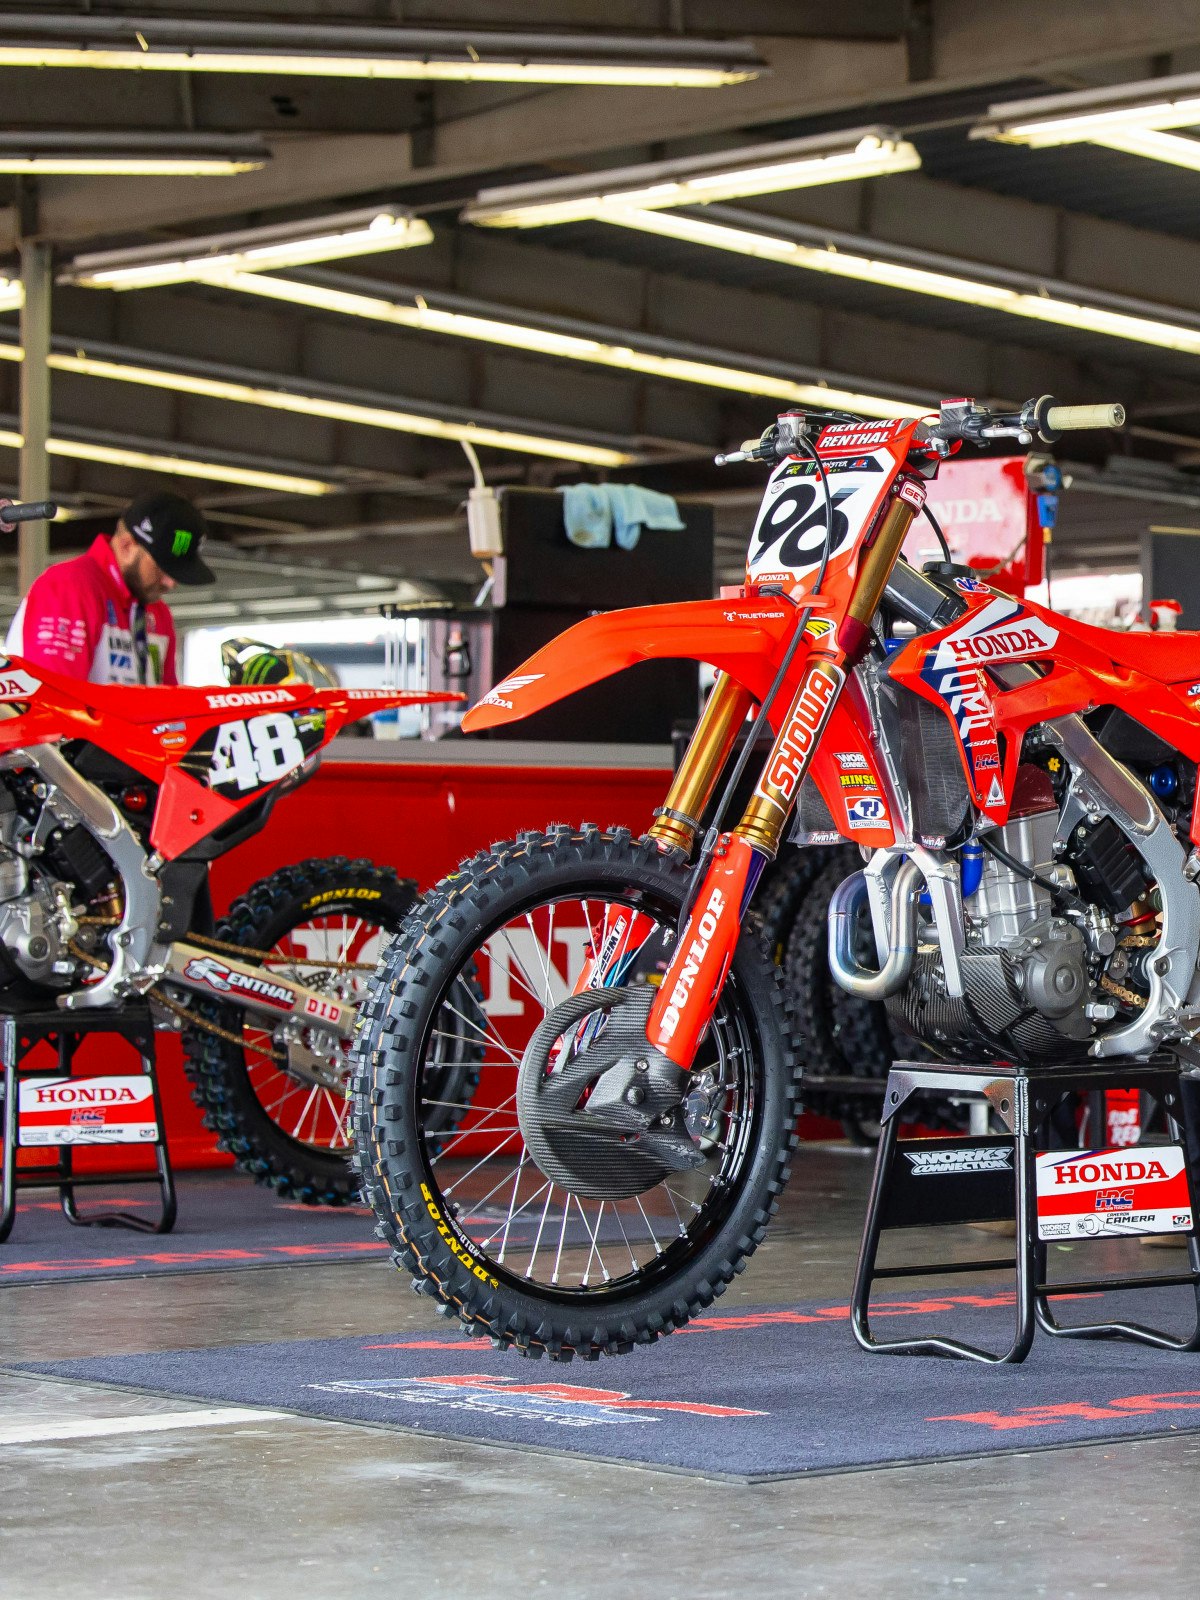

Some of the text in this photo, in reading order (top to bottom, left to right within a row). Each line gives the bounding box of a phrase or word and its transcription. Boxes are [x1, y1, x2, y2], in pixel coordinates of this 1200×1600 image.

[820, 433, 890, 448] RENTHAL
[758, 483, 849, 568] 96
[757, 574, 790, 582] HONDA
[947, 628, 1048, 662] HONDA
[206, 689, 296, 709] HONDA
[938, 670, 994, 740] CRF
[768, 670, 836, 800] SHOWA
[209, 712, 304, 790] 48
[976, 754, 999, 768] HRC
[840, 774, 877, 786] HINSO
[860, 801, 879, 817] TJ
[812, 833, 828, 842] Twin
[308, 888, 382, 907] DUNLOP
[660, 887, 725, 1038] DUNLOP
[36, 1087, 136, 1103] HONDA
[909, 1148, 1011, 1164] WORKS
[914, 1160, 1009, 1174] CONNECTION
[1054, 1161, 1170, 1184] HONDA
[1095, 1189, 1134, 1207] HRC
[1078, 1222, 1086, 1230] 96
[1105, 1214, 1155, 1224] CAMERA
[420, 1183, 489, 1282] DUNLOP
